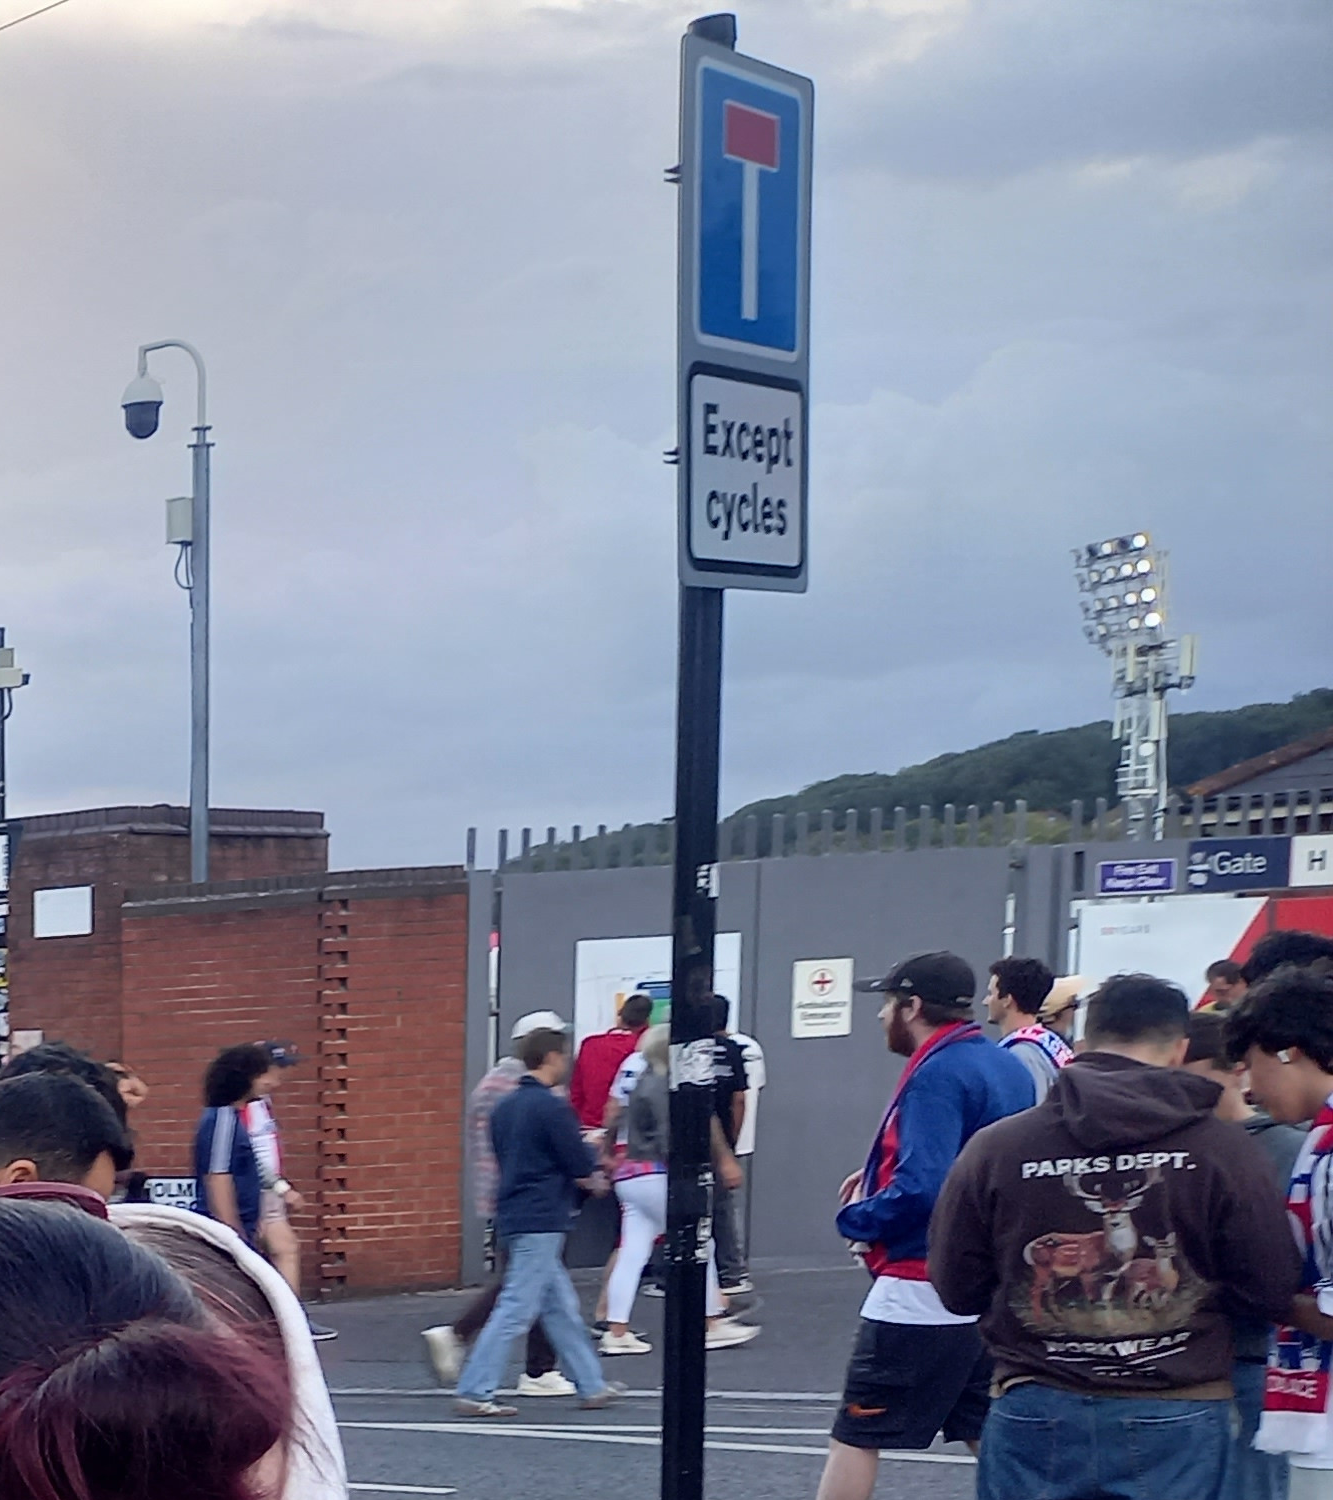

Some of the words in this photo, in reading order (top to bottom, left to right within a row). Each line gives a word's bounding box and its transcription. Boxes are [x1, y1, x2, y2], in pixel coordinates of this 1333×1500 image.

[701, 402, 794, 473] Except
[706, 482, 787, 540] cycles
[1213, 850, 1268, 876] Gate
[1022, 1157, 1110, 1179] PARKS
[1116, 1152, 1197, 1172] DEPT.
